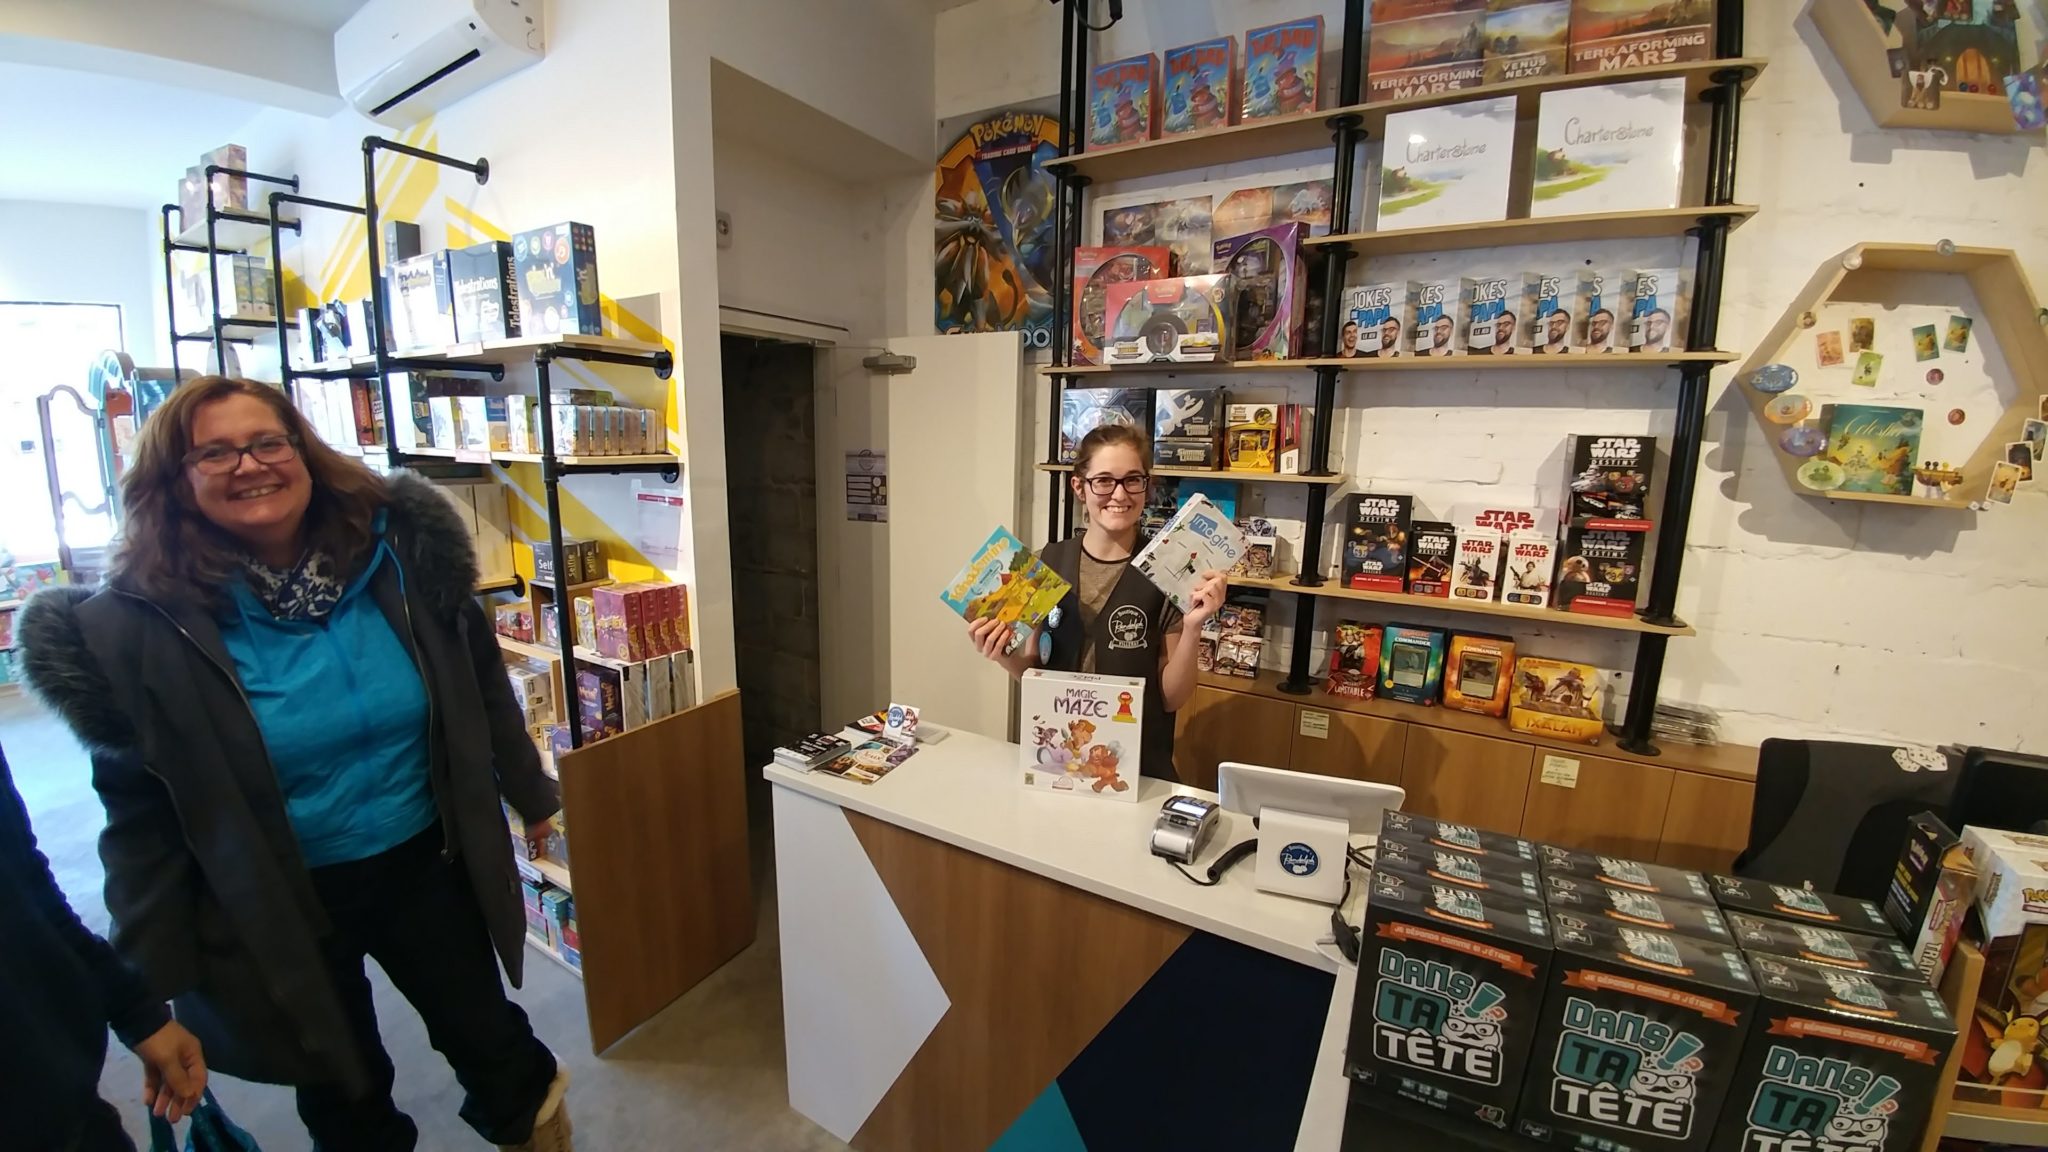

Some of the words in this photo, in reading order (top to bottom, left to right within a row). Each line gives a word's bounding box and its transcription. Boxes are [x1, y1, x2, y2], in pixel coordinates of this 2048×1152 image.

[1574, 33, 1706, 62] TERRAFORMING
[1502, 56, 1548, 71] VENUS
[1599, 48, 1678, 72] MARS
[1505, 66, 1543, 79] NEXT
[1393, 80, 1462, 99] MARS
[1003, 147, 1016, 156] CARD
[1017, 144, 1032, 152] GAME
[507, 256, 521, 328] Telestrations
[1352, 287, 1392, 309] JOKES
[1590, 438, 1641, 449] STAR
[1590, 448, 1641, 458] WARS
[1359, 498, 1400, 508] STAR
[1359, 507, 1400, 517] WARS
[1475, 510, 1534, 523] STAR
[1418, 535, 1450, 543] STAR
[1462, 540, 1494, 548] STAR
[1581, 540, 1630, 550] WARS
[1418, 542, 1450, 550] WARS
[1462, 546, 1494, 554] WARS
[1515, 544, 1549, 552] STAR
[1515, 550, 1549, 558] WARS
[1395, 637, 1432, 646] COMMANDER
[1463, 646, 1502, 656] COMMANDER
[1066, 688, 1098, 699] MAGIC
[1334, 685, 1365, 697] UNSTABLE
[1054, 696, 1108, 718] MAZE
[1526, 718, 1584, 737] IXALAN
[1394, 926, 1405, 934] JE
[1379, 948, 1476, 1001] DANS
[1387, 988, 1441, 1031] TA
[1563, 997, 1673, 1052] DANS
[1381, 1027, 1494, 1078] TÊTE
[1571, 1040, 1630, 1085] TA
[1762, 1045, 1874, 1099] DANS
[1561, 1081, 1684, 1132] TÊTE
[1769, 1090, 1828, 1132] TA
